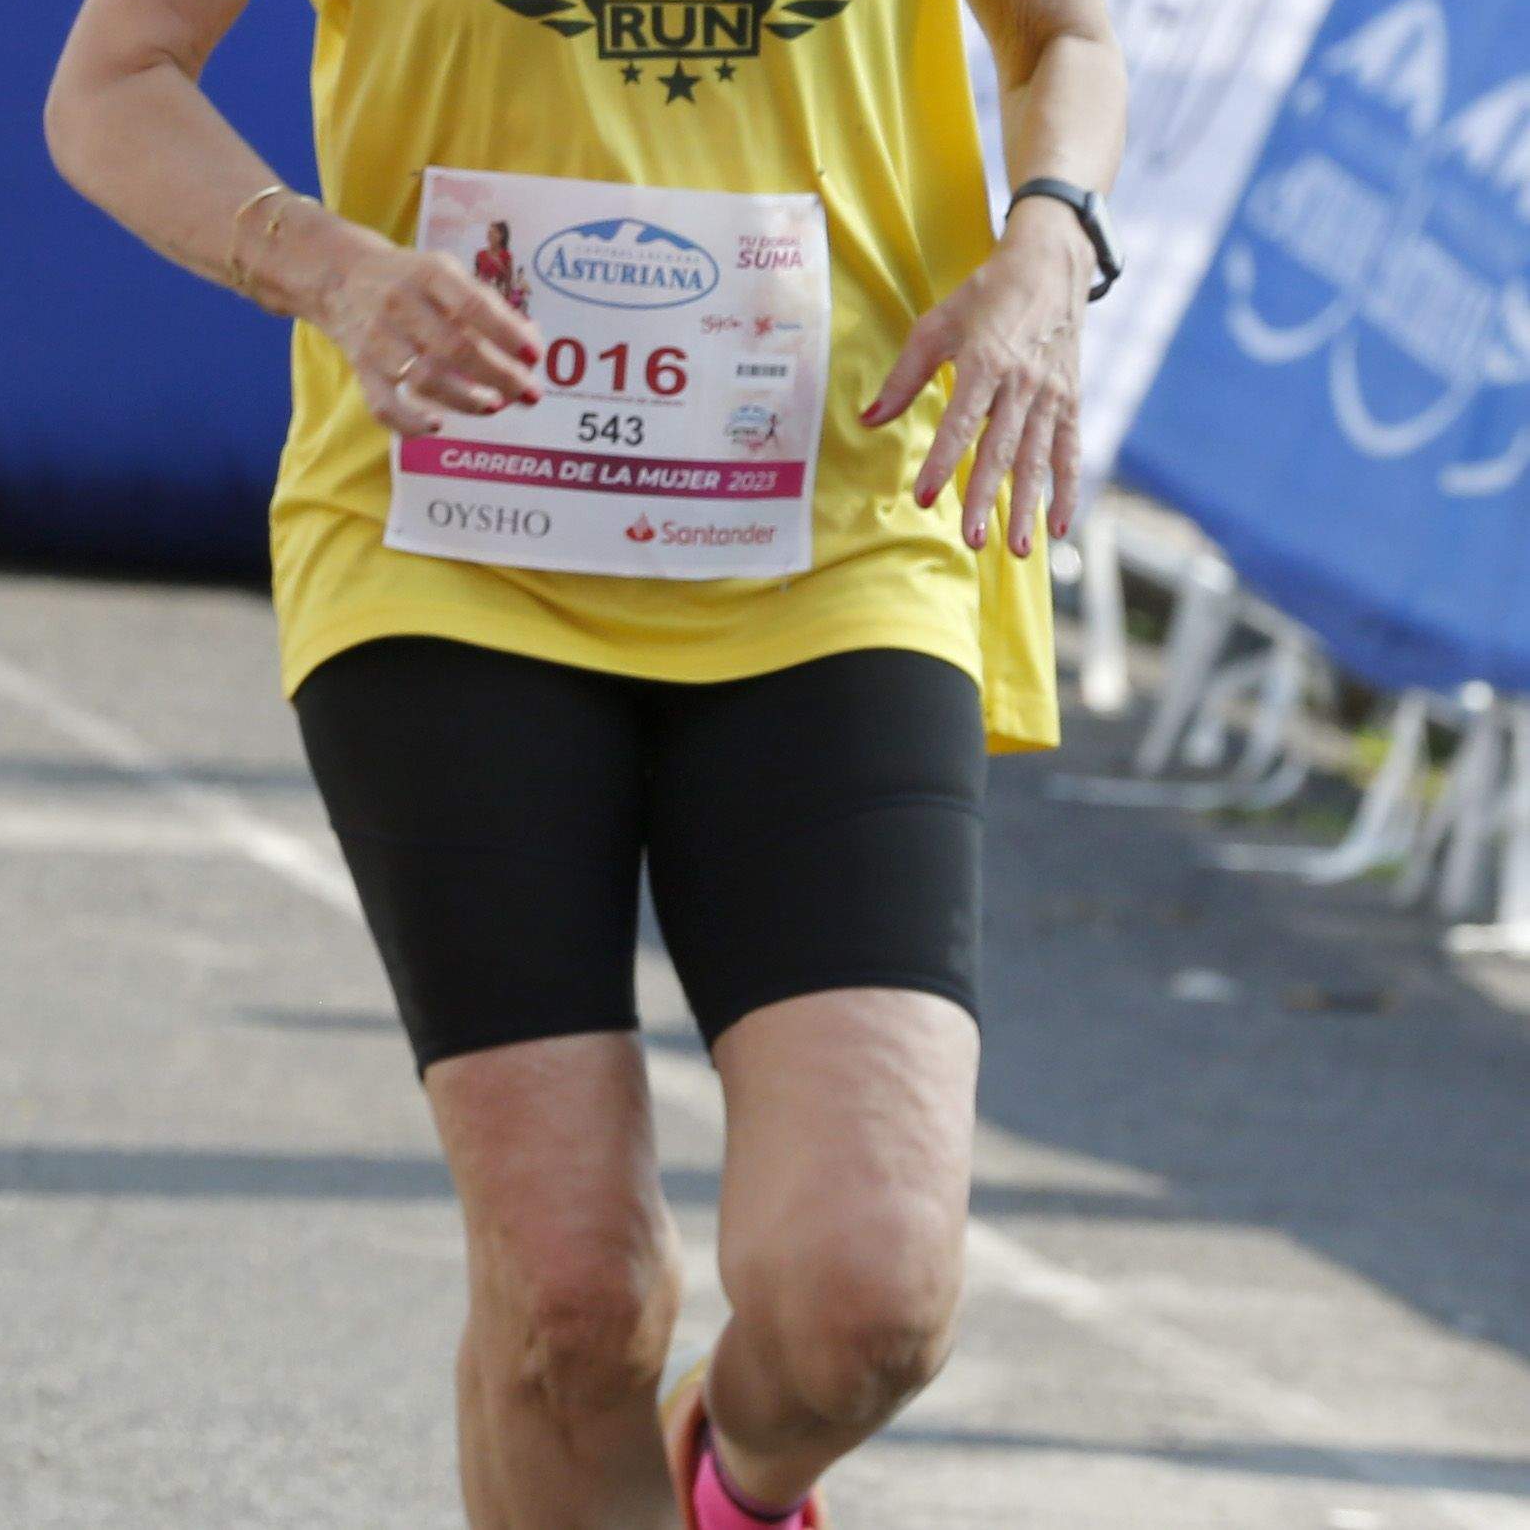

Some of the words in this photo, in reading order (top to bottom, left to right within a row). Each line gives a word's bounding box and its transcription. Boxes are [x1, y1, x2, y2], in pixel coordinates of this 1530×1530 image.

[610, 5, 748, 48] RUN
[545, 247, 704, 290] ASTURIANA
[736, 249, 804, 271] SUMA
[545, 336, 688, 396] 016
[577, 412, 645, 446] 543
[440, 448, 554, 480] CARRERA
[559, 460, 595, 484] DE
[599, 464, 633, 487] LA
[637, 467, 721, 492] MUJER
[726, 470, 779, 493] 2023
[426, 500, 552, 539] OYSHO
[661, 521, 777, 547] Santander
